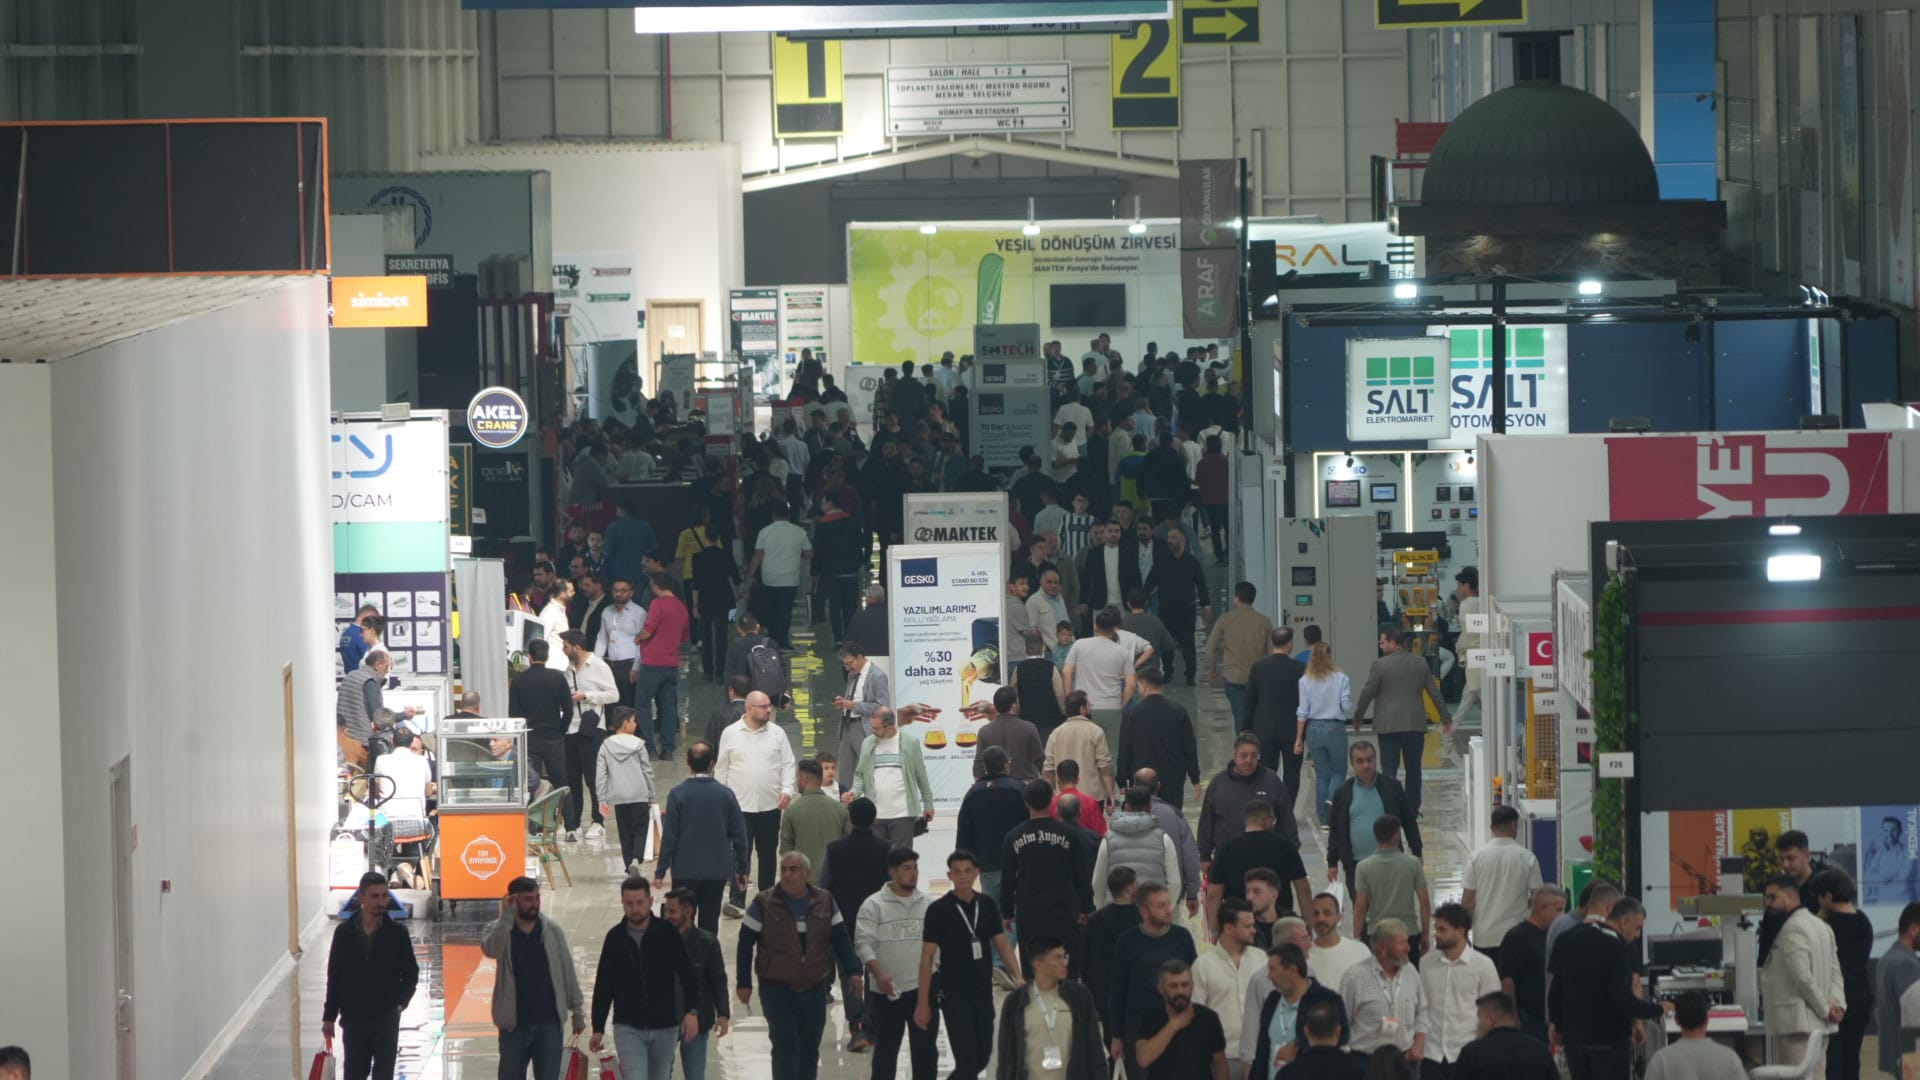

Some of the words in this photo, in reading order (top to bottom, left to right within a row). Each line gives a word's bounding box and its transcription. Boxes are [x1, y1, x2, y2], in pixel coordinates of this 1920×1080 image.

[1119, 19, 1171, 95] 2
[928, 68, 954, 77] SALON
[896, 84, 934, 93] TOPLANTI
[936, 83, 978, 91] SALONLARI
[986, 82, 1020, 90] MEETING
[1022, 81, 1050, 89] ROOMS
[975, 106, 1020, 115] RESTAURANT
[996, 119, 1011, 127] WC
[995, 235, 1036, 254] YEŞİL
[1041, 234, 1116, 253] DÖNÜŞÜM
[1121, 232, 1176, 249] ZİRVESİ
[388, 258, 449, 270] SEKRETERYA
[1197, 257, 1215, 317] ARAF
[741, 311, 776, 321] MAKTEK
[1367, 389, 1430, 414] SALT
[473, 405, 521, 419] AKEL
[477, 420, 517, 430] CRANE
[1366, 415, 1434, 424] ELEKTROMARKET
[1450, 413, 1546, 429] OTOMSYON
[933, 526, 998, 542] MAKTEK
[904, 574, 935, 585] GESKO
[903, 604, 977, 615] YAZILIMLARIMIZ
[924, 650, 953, 663] %30
[904, 665, 935, 678] daha
[938, 666, 953, 677] az
[1609, 761, 1623, 769] F26
[1037, 829, 1071, 849] Angels
[1906, 807, 1918, 860] MEDİKAL
